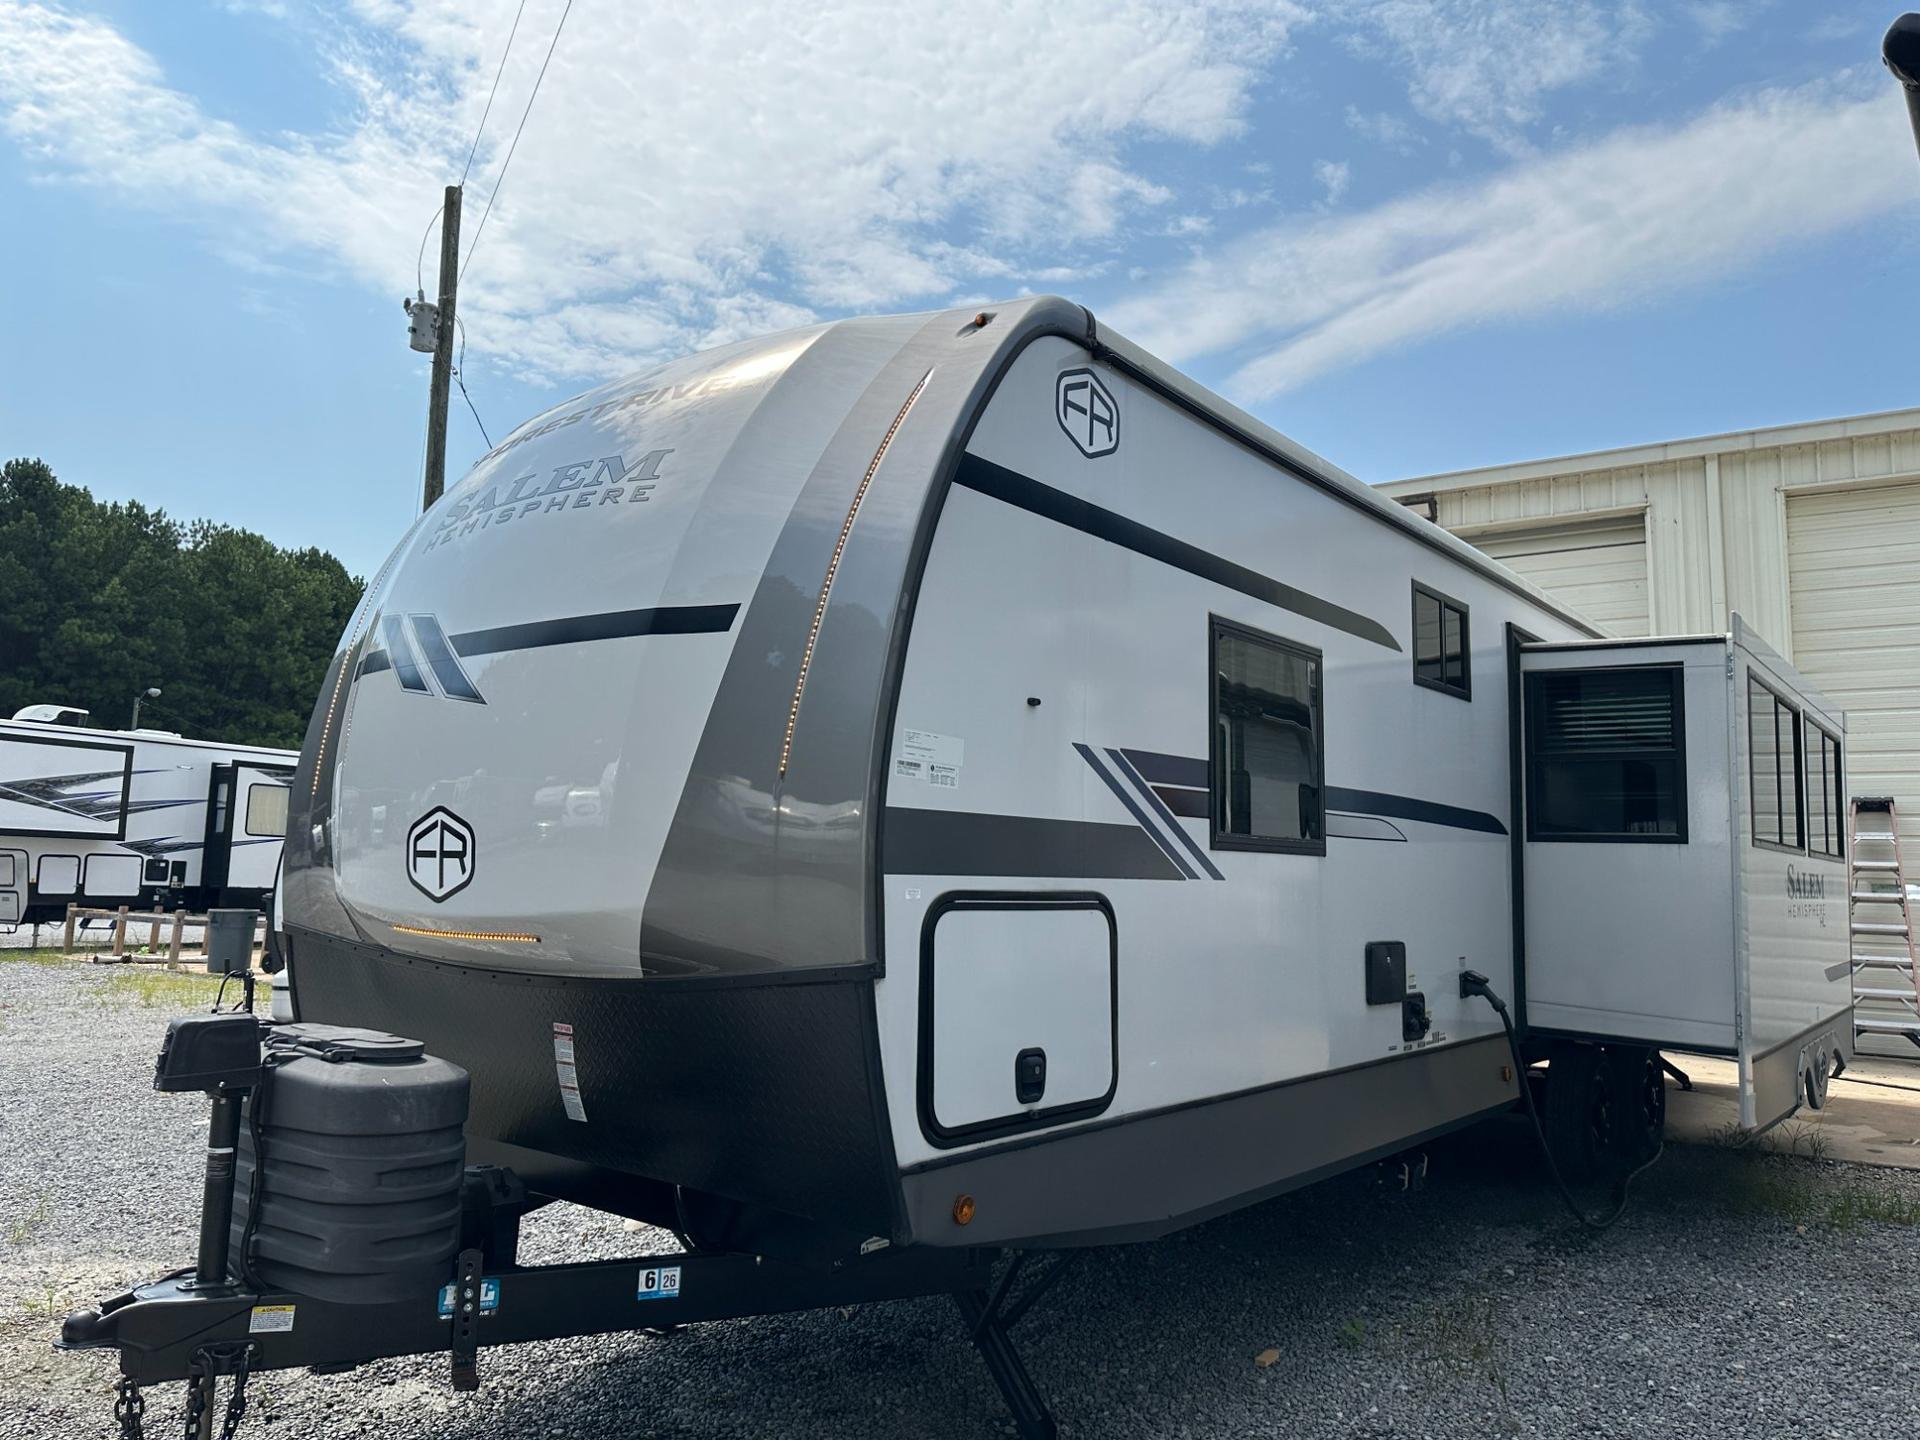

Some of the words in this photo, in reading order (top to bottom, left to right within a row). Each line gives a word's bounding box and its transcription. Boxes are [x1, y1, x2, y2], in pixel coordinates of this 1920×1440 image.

[422, 484, 655, 555] HEMISPHERE
[434, 448, 676, 535] SALEM
[645, 1270, 656, 1290] 6
[663, 1273, 676, 1289] 26
